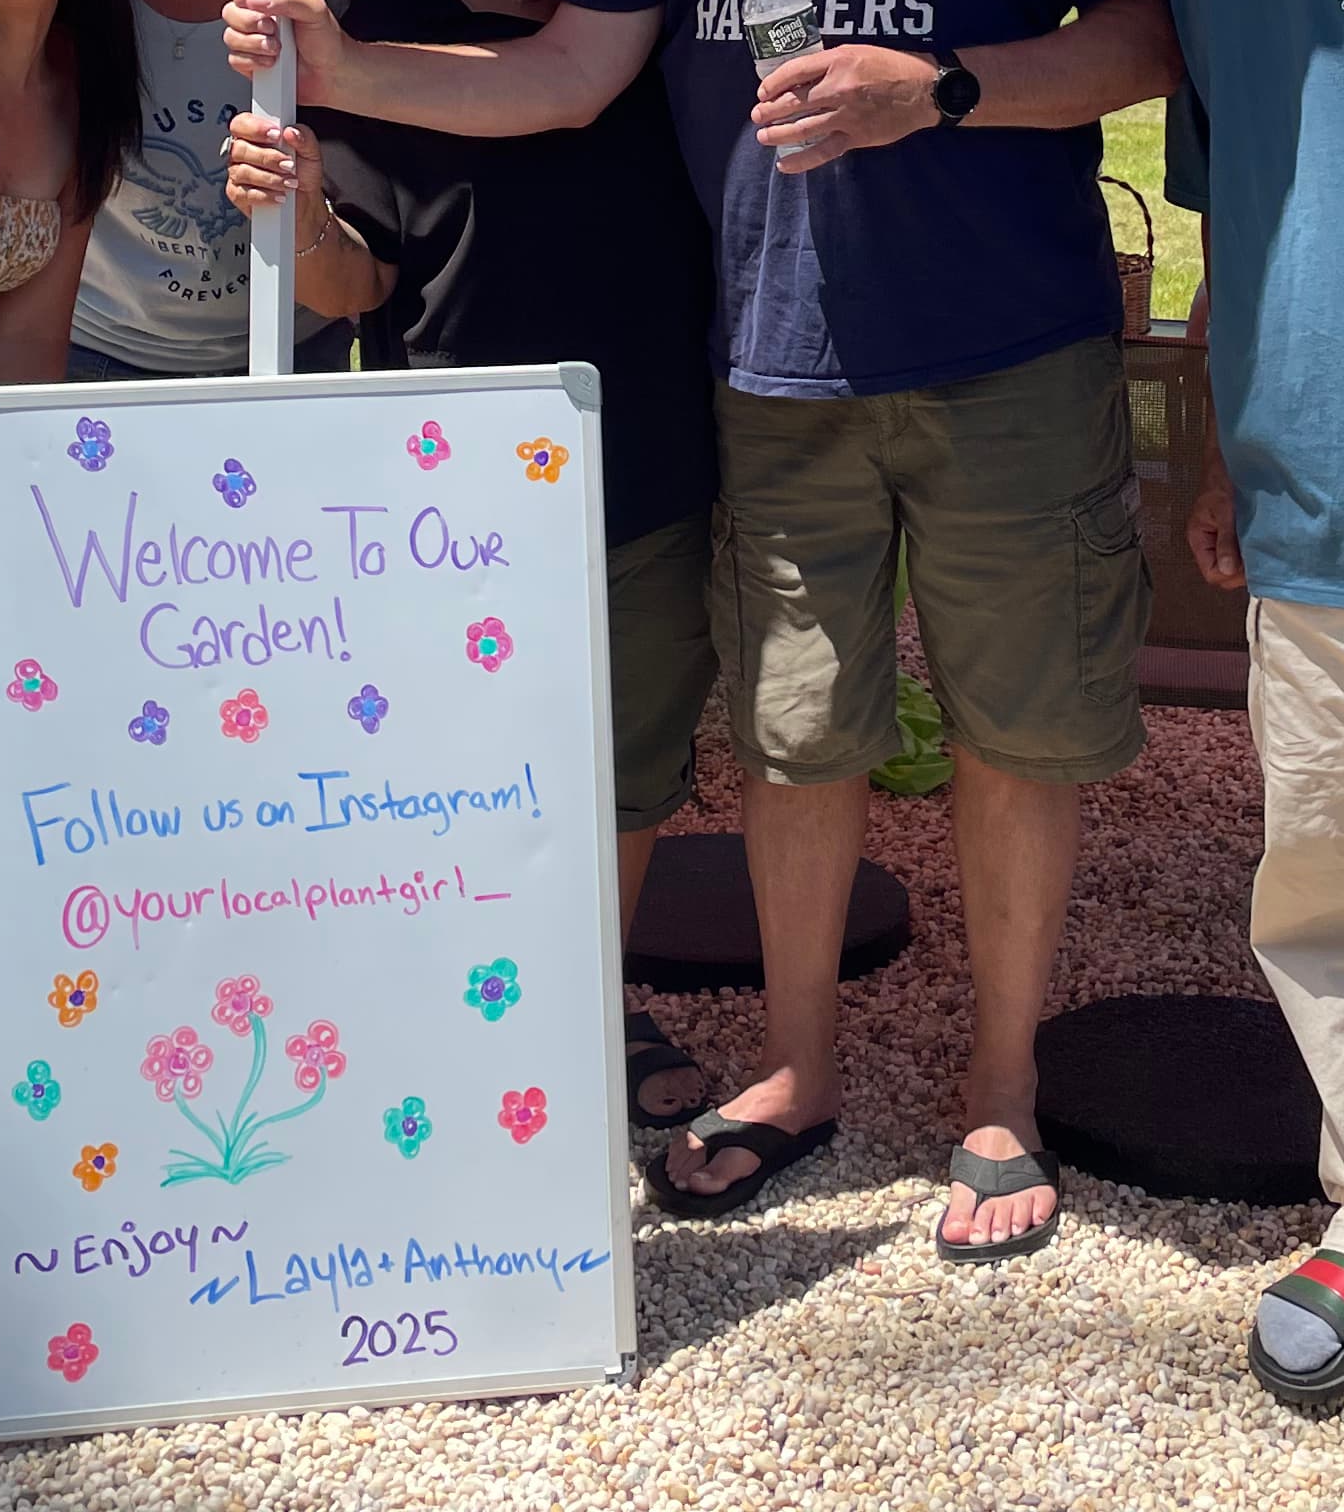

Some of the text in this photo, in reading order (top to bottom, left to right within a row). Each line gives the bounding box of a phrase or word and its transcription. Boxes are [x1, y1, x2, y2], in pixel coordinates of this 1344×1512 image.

[768, 16, 807, 53] Poland Spring
[158, 269, 249, 302] FOREVER
[201, 270, 212, 282] &
[30, 484, 317, 607] Welcome
[321, 505, 388, 580] To
[139, 596, 353, 669] Garden!
[21, 762, 542, 866] Follow us on Instagram!
[340, 1309, 459, 1367] 2025
